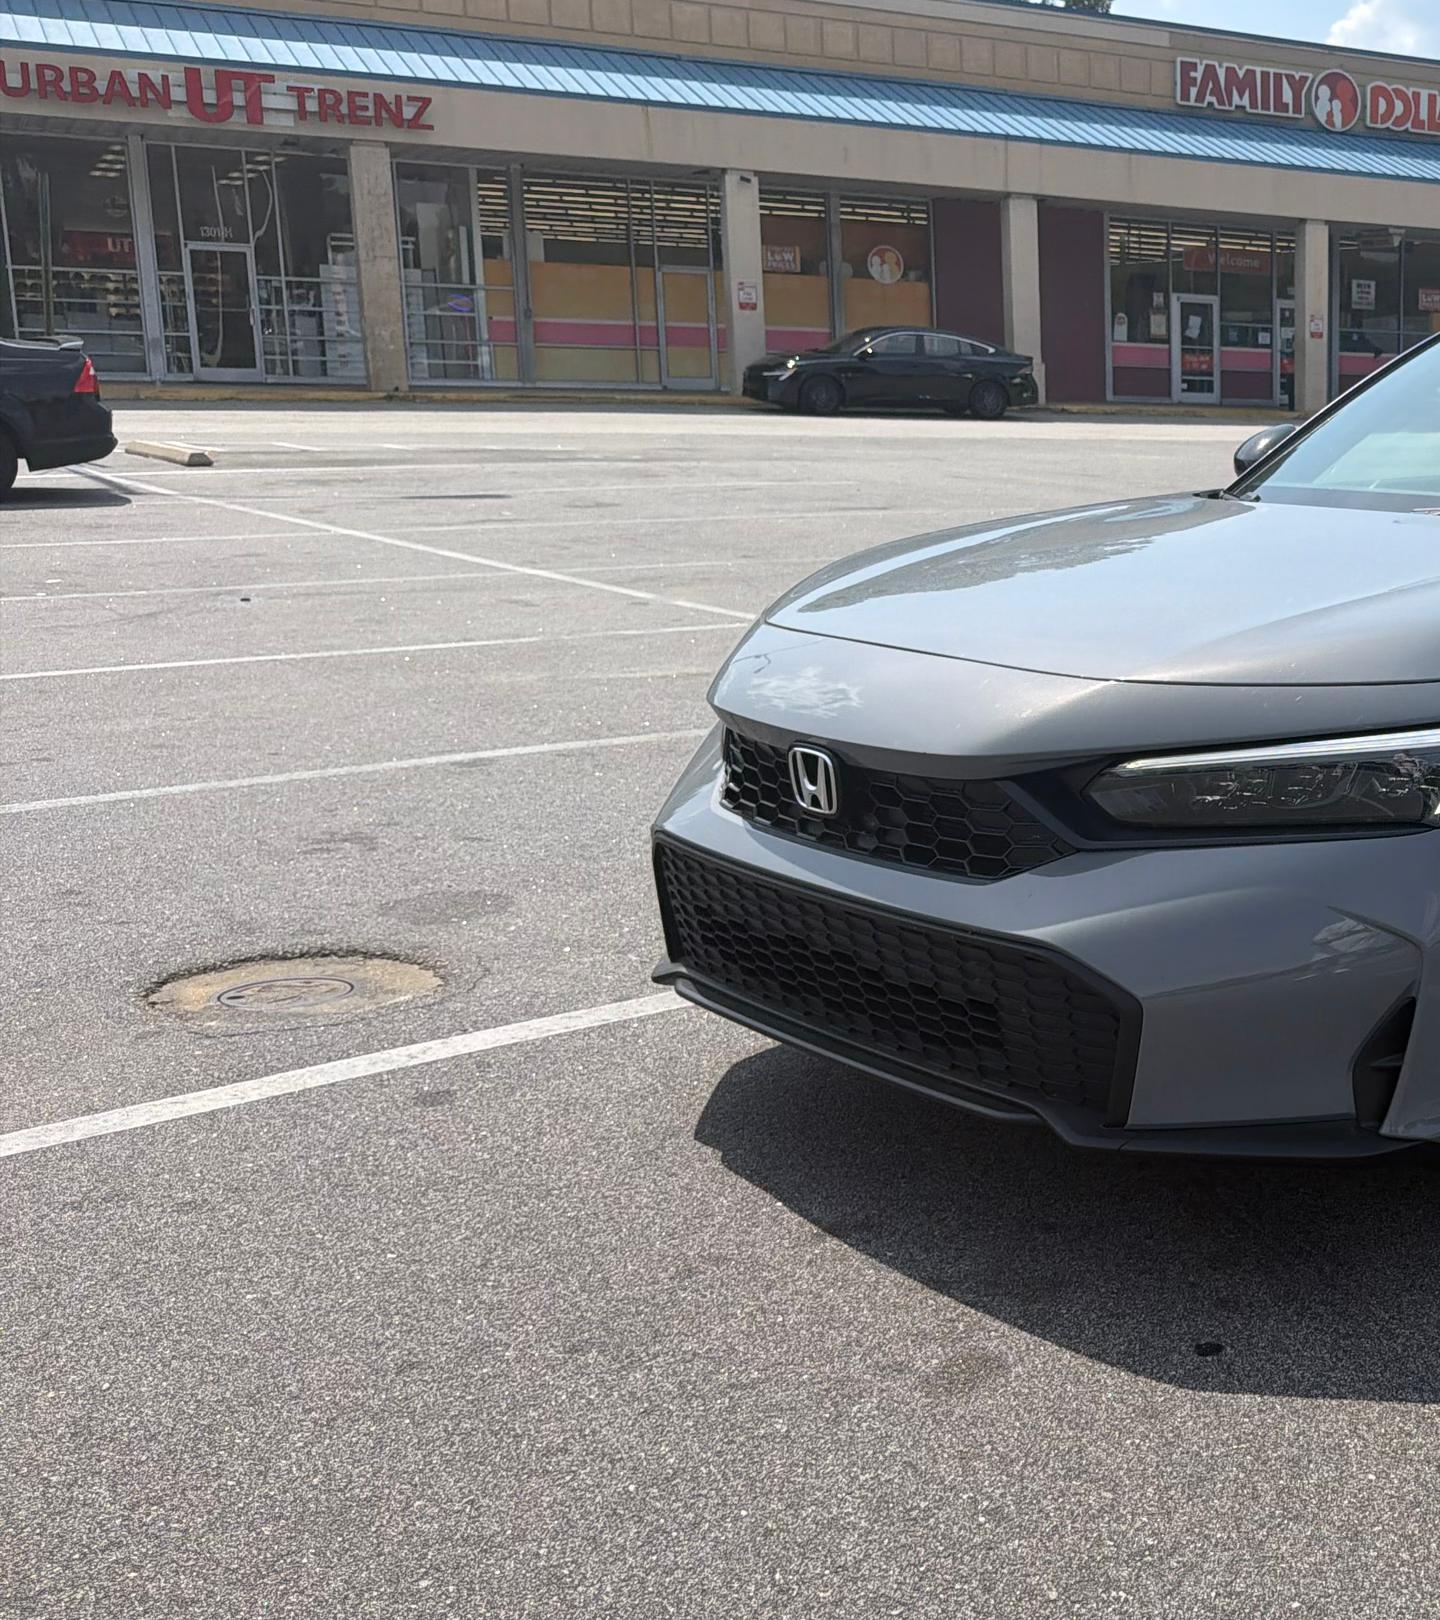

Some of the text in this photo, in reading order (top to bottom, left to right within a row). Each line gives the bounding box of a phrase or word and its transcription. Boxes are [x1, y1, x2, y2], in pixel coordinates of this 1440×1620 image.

[0, 60, 434, 131] URBAN UT TRENZ
[1178, 58, 1312, 118] FAMILY
[107, 237, 132, 252] UT
[1207, 251, 1261, 268] Welcome
